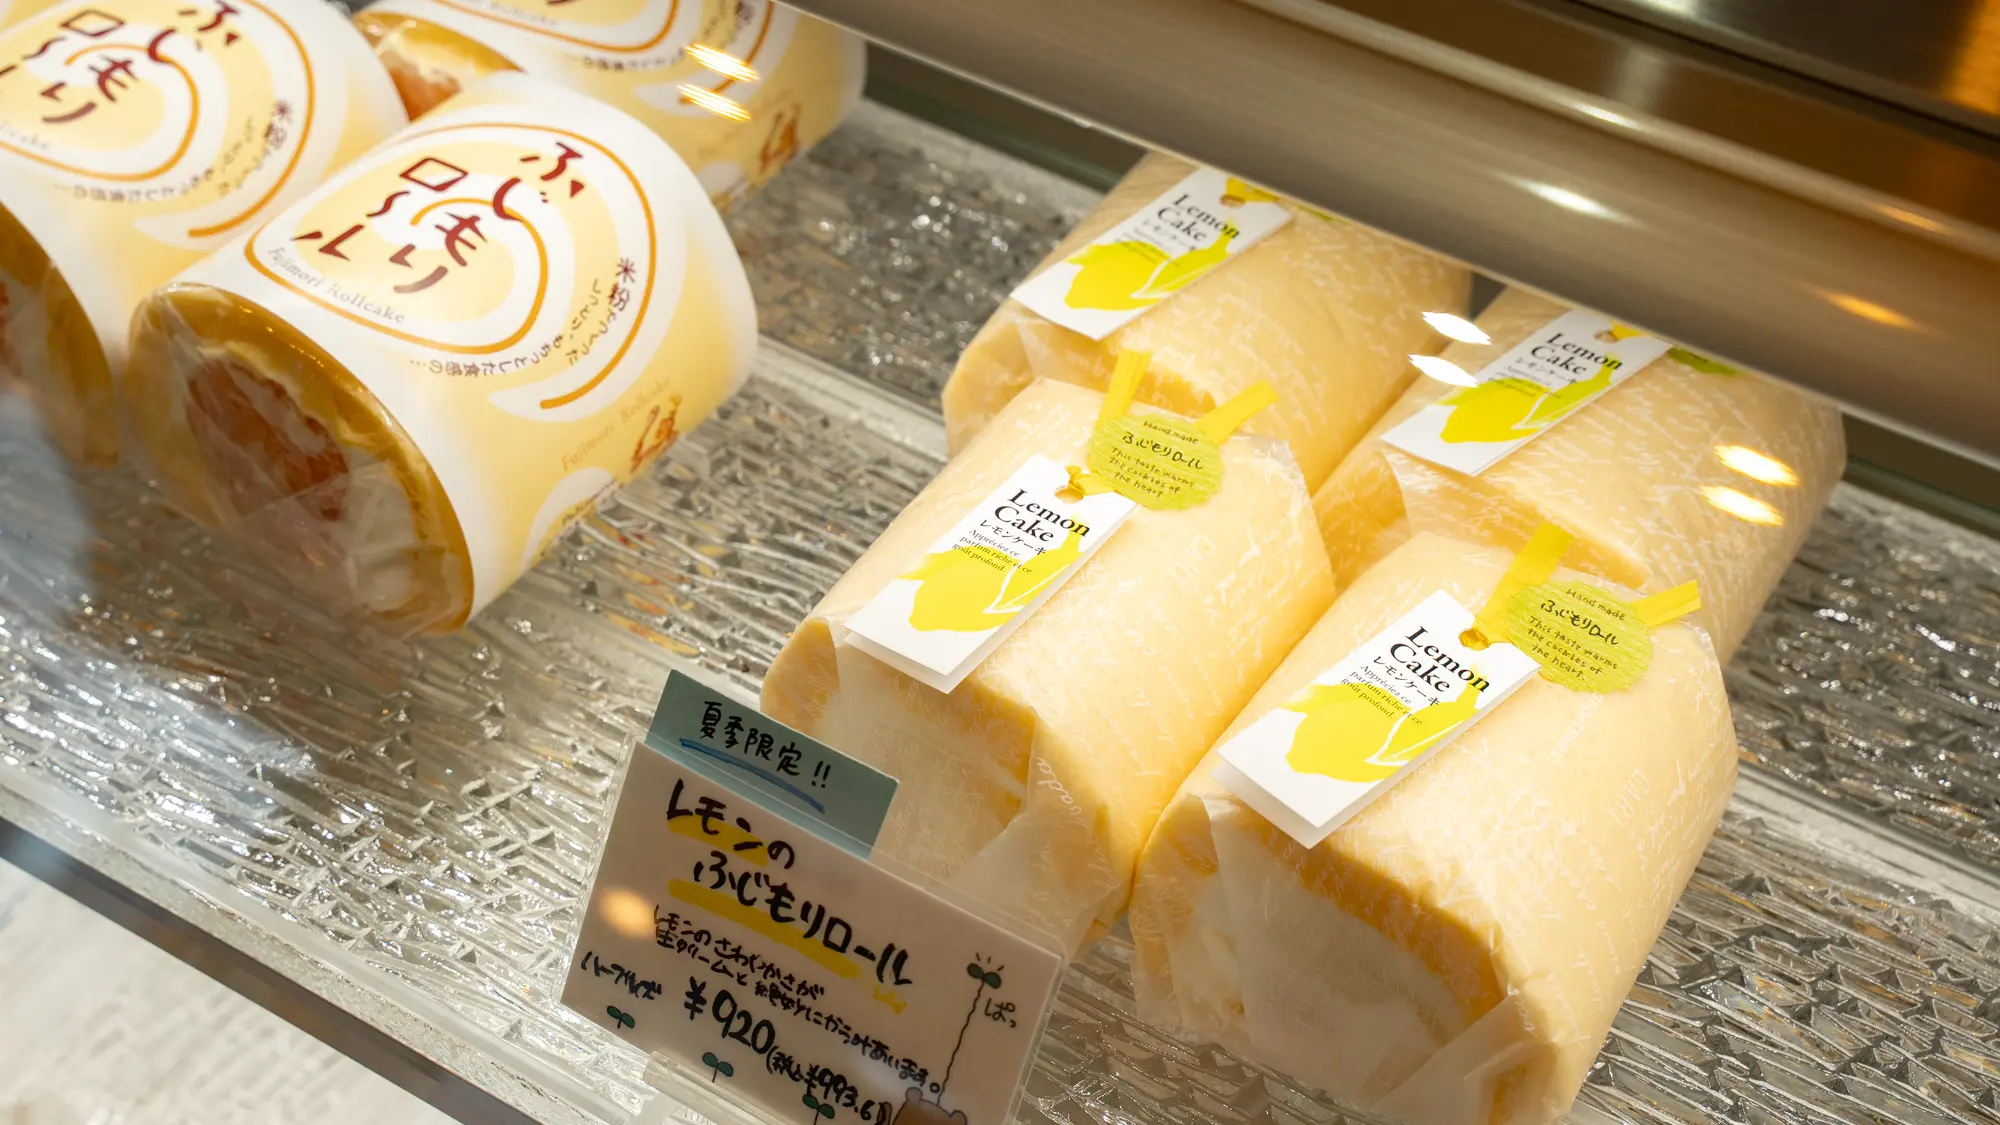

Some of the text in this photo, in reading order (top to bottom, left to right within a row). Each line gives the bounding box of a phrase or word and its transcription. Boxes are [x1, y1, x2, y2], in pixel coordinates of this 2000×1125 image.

[292, 156, 469, 262] ロール
[388, 141, 586, 294] ふじもり
[1157, 207, 1207, 242] Cake
[1170, 193, 1241, 240] Lemon
[267, 246, 405, 325] Fujimori Rollcake
[1530, 345, 1587, 375] Cake
[1546, 332, 1624, 371] Lemon
[1112, 447, 1132, 460] This
[1121, 431, 1204, 470] ふじもりロール
[994, 505, 1055, 542] Cake
[1007, 487, 1091, 538] Lemon
[952, 543, 1006, 573] goût profond.
[959, 535, 991, 558] parfum
[991, 549, 1013, 565] riche
[1022, 566, 1033, 574] ce
[968, 528, 1020, 558] Appréciez ce
[979, 518, 1046, 556] レモンケーキ
[1541, 599, 1619, 646] ふじもりロール
[1566, 589, 1626, 621] Hand made
[1404, 625, 1491, 693] Lemon
[1527, 628, 1603, 676] the cockles of
[1529, 615, 1619, 670] This taste warms
[1531, 643, 1584, 681] the heart.
[1360, 664, 1412, 705] Appréciez ce
[1372, 655, 1440, 708] レモンケーキ
[1389, 643, 1452, 693] Cake
[1340, 677, 1394, 720] goût profond.
[1349, 670, 1382, 700] parfum
[1381, 692, 1404, 711] riche
[1412, 715, 1423, 725] ce
[700, 701, 831, 788] 夏季限定!!
[667, 778, 795, 869] レモンの
[693, 850, 913, 986] ふじもりロール
[683, 976, 775, 1054] ¥920
